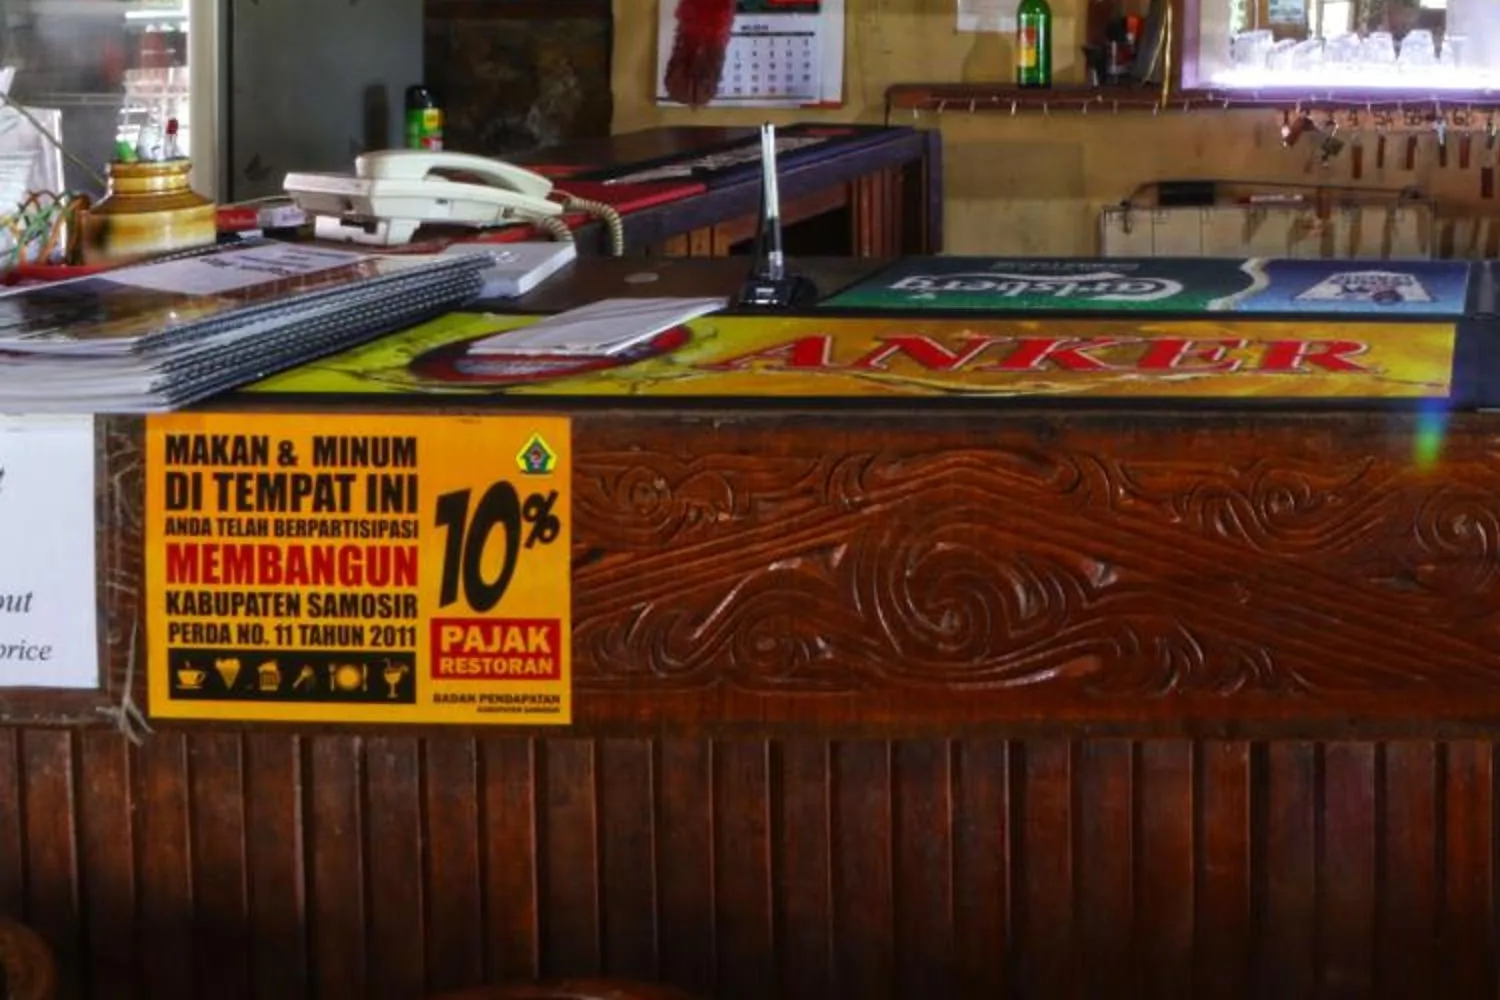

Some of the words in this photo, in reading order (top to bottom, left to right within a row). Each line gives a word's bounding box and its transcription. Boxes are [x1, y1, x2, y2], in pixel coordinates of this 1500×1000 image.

[889, 272, 1184, 301] Carlsberg
[705, 334, 1377, 374] ANKER
[165, 434, 269, 466] MAKAN
[277, 440, 298, 467] &
[312, 435, 417, 467] MINUM
[165, 471, 203, 512] DI
[213, 472, 357, 513] TEMPAT
[366, 474, 418, 514] INI
[165, 518, 212, 537] ANDA
[216, 518, 269, 537] TELAH
[274, 519, 419, 539] BERPARTISIPASI
[435, 479, 561, 614] 10%
[165, 543, 418, 587] MEMBANGUN
[165, 590, 300, 618] KABUPATEN
[307, 592, 418, 619] SAMOSIR
[168, 622, 232, 644] PERDA
[237, 623, 270, 645] NO.
[275, 624, 293, 645] 11
[298, 624, 364, 646] TAHUN
[369, 625, 417, 648] 2011
[441, 625, 552, 654] PAJAK
[440, 657, 553, 675] RESTORAN
